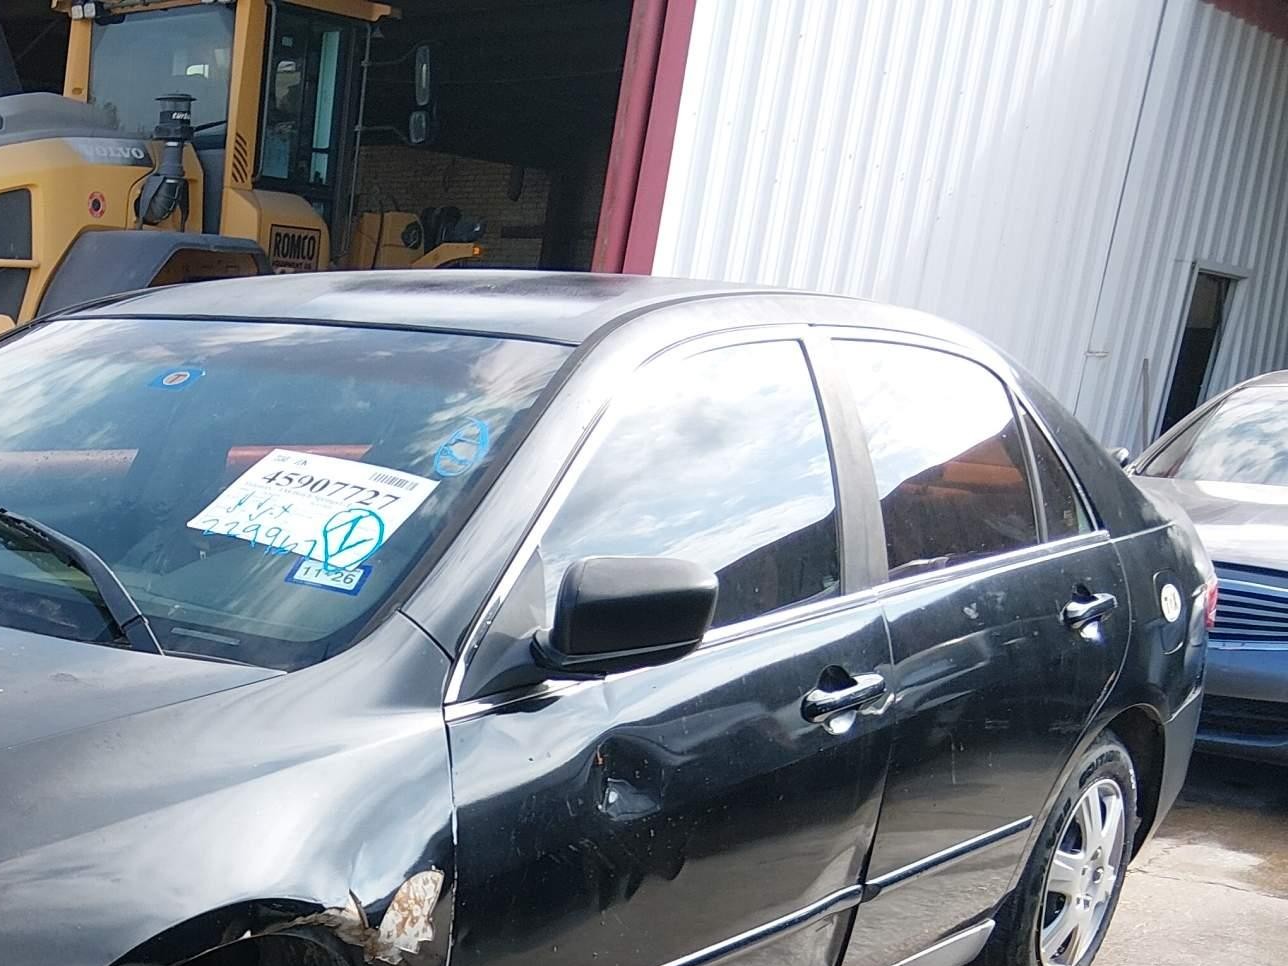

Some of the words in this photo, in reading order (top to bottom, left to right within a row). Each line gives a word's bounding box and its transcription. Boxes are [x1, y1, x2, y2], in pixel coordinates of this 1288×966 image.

[82, 145, 145, 159] VOLVO
[272, 231, 317, 261] ROMCO
[261, 470, 400, 511] 45907727
